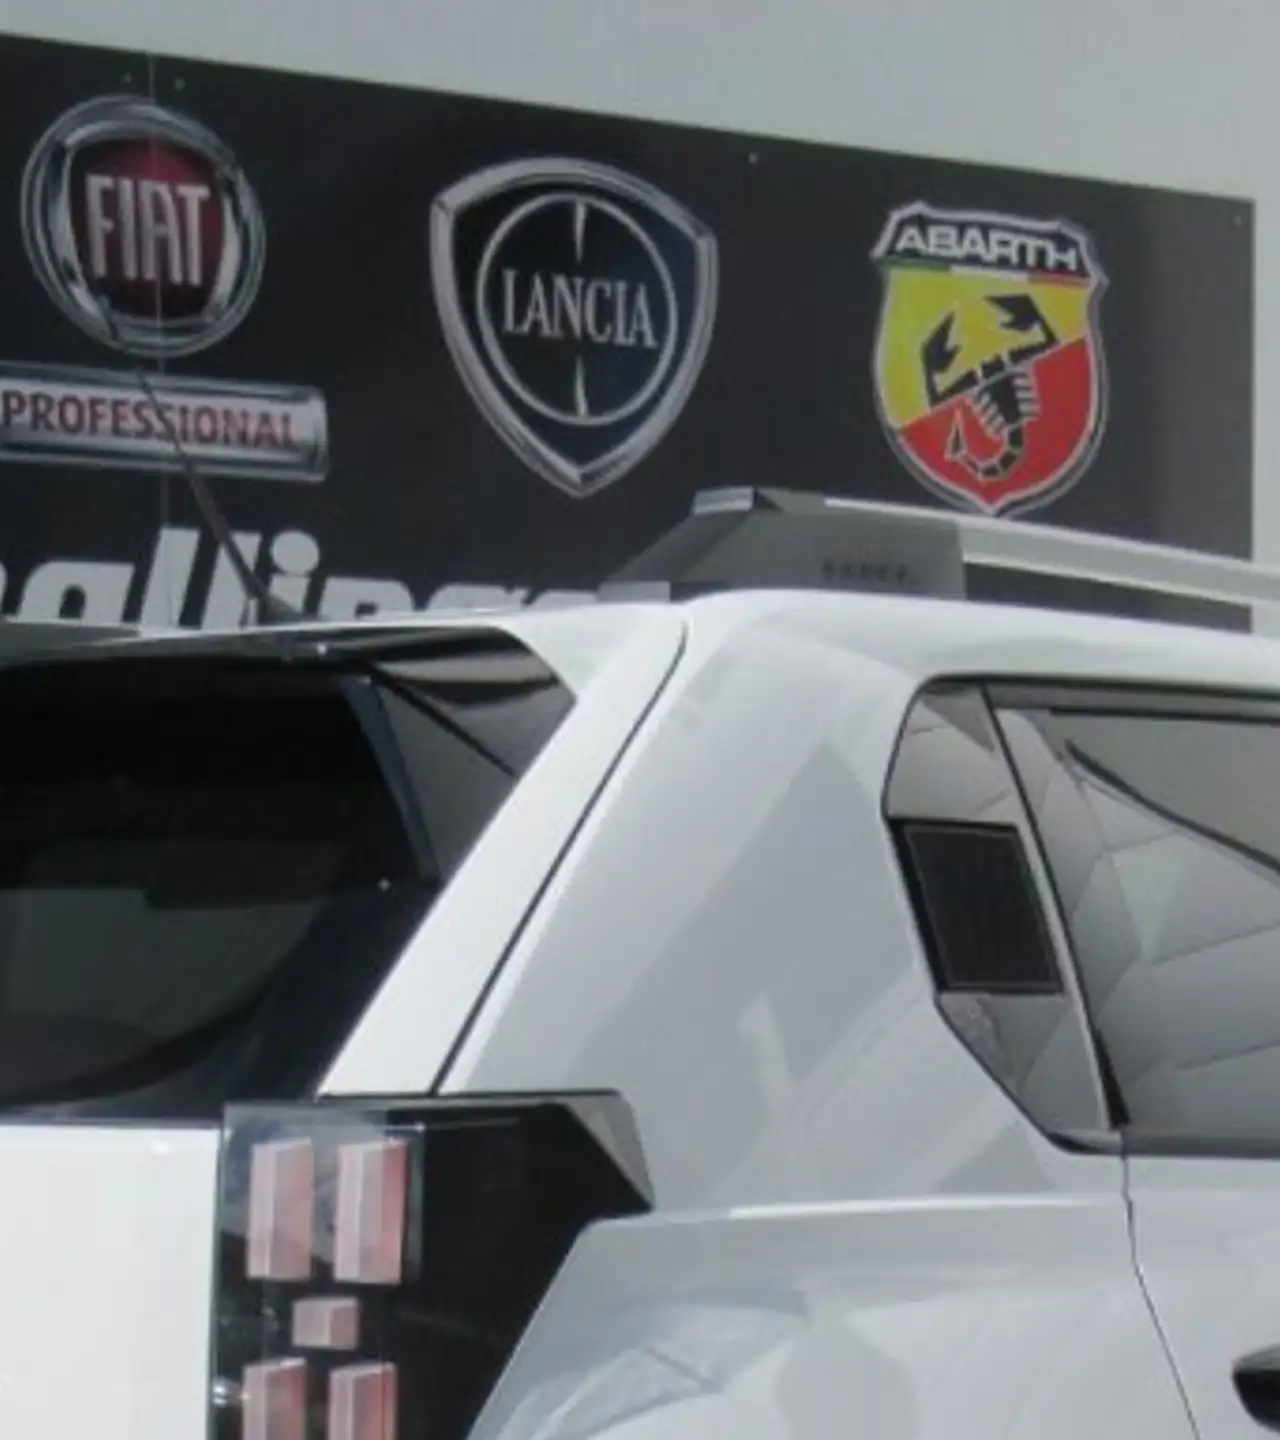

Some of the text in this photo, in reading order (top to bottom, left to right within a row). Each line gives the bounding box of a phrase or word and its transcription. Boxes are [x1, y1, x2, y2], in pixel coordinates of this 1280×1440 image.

[84, 173, 210, 289] FIAT
[895, 225, 1077, 271] ABARTH
[502, 269, 656, 350] LANCIA
[1, 390, 297, 449] PROFESSIONAL
